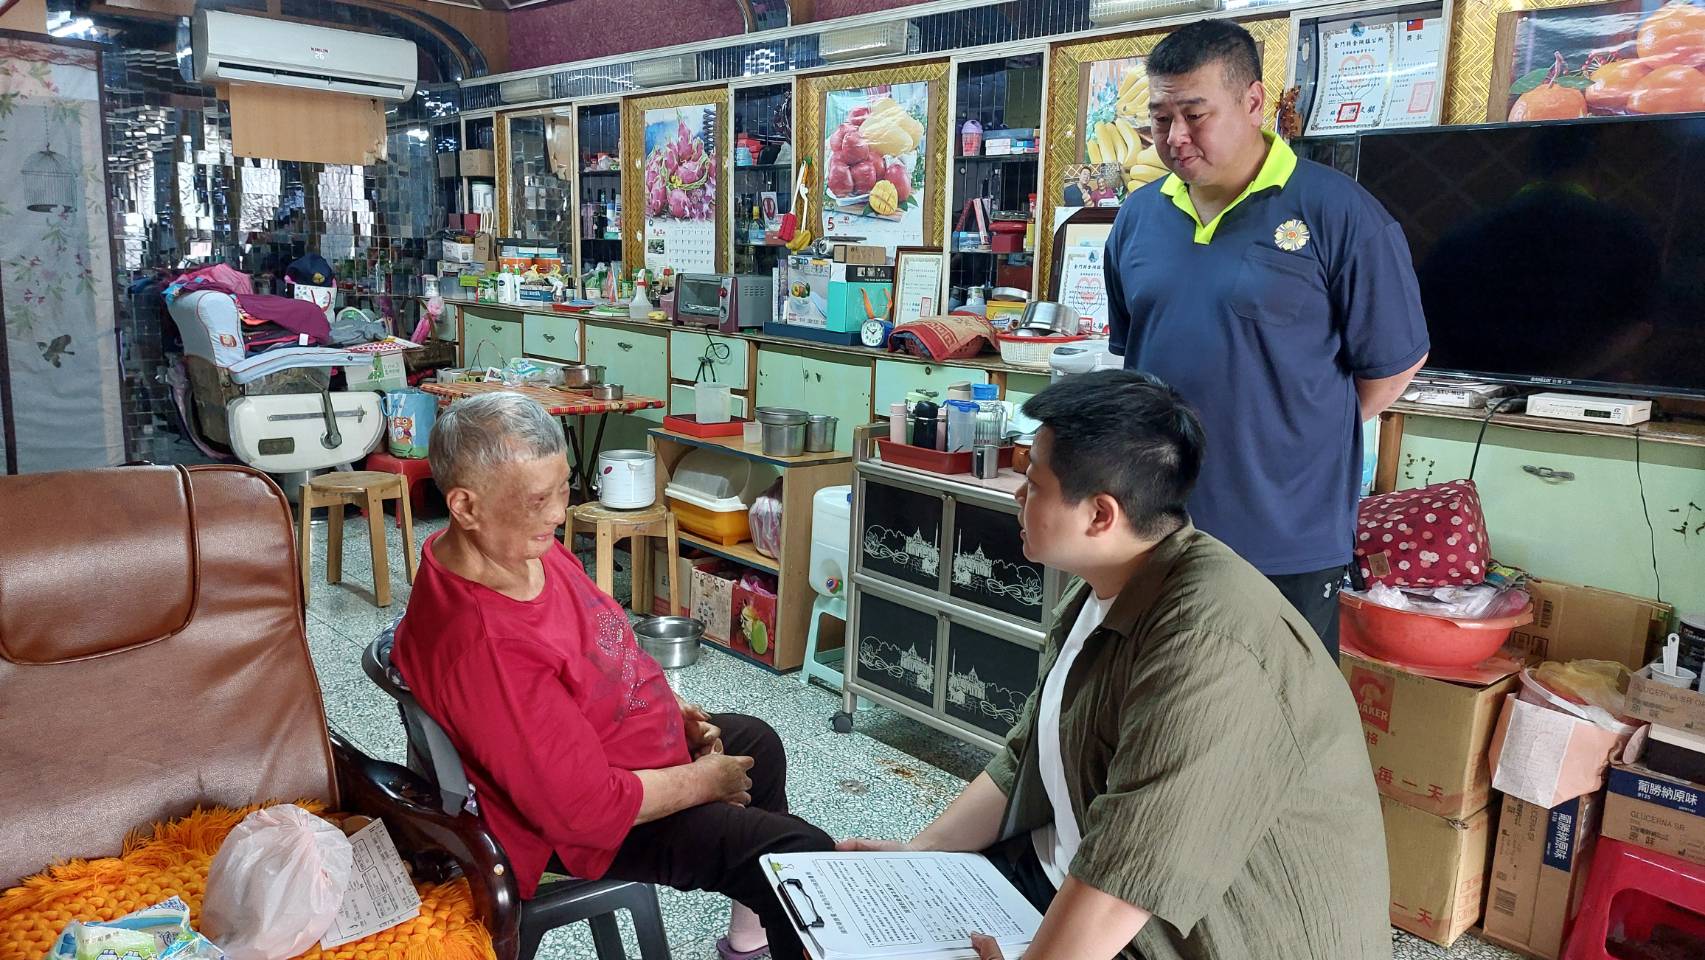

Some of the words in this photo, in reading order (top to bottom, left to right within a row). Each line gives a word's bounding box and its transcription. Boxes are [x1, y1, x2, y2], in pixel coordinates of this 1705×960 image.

[827, 216, 835, 231] 5
[1359, 703, 1388, 721] AKER
[1637, 780, 1698, 806] 葡勝納原味
